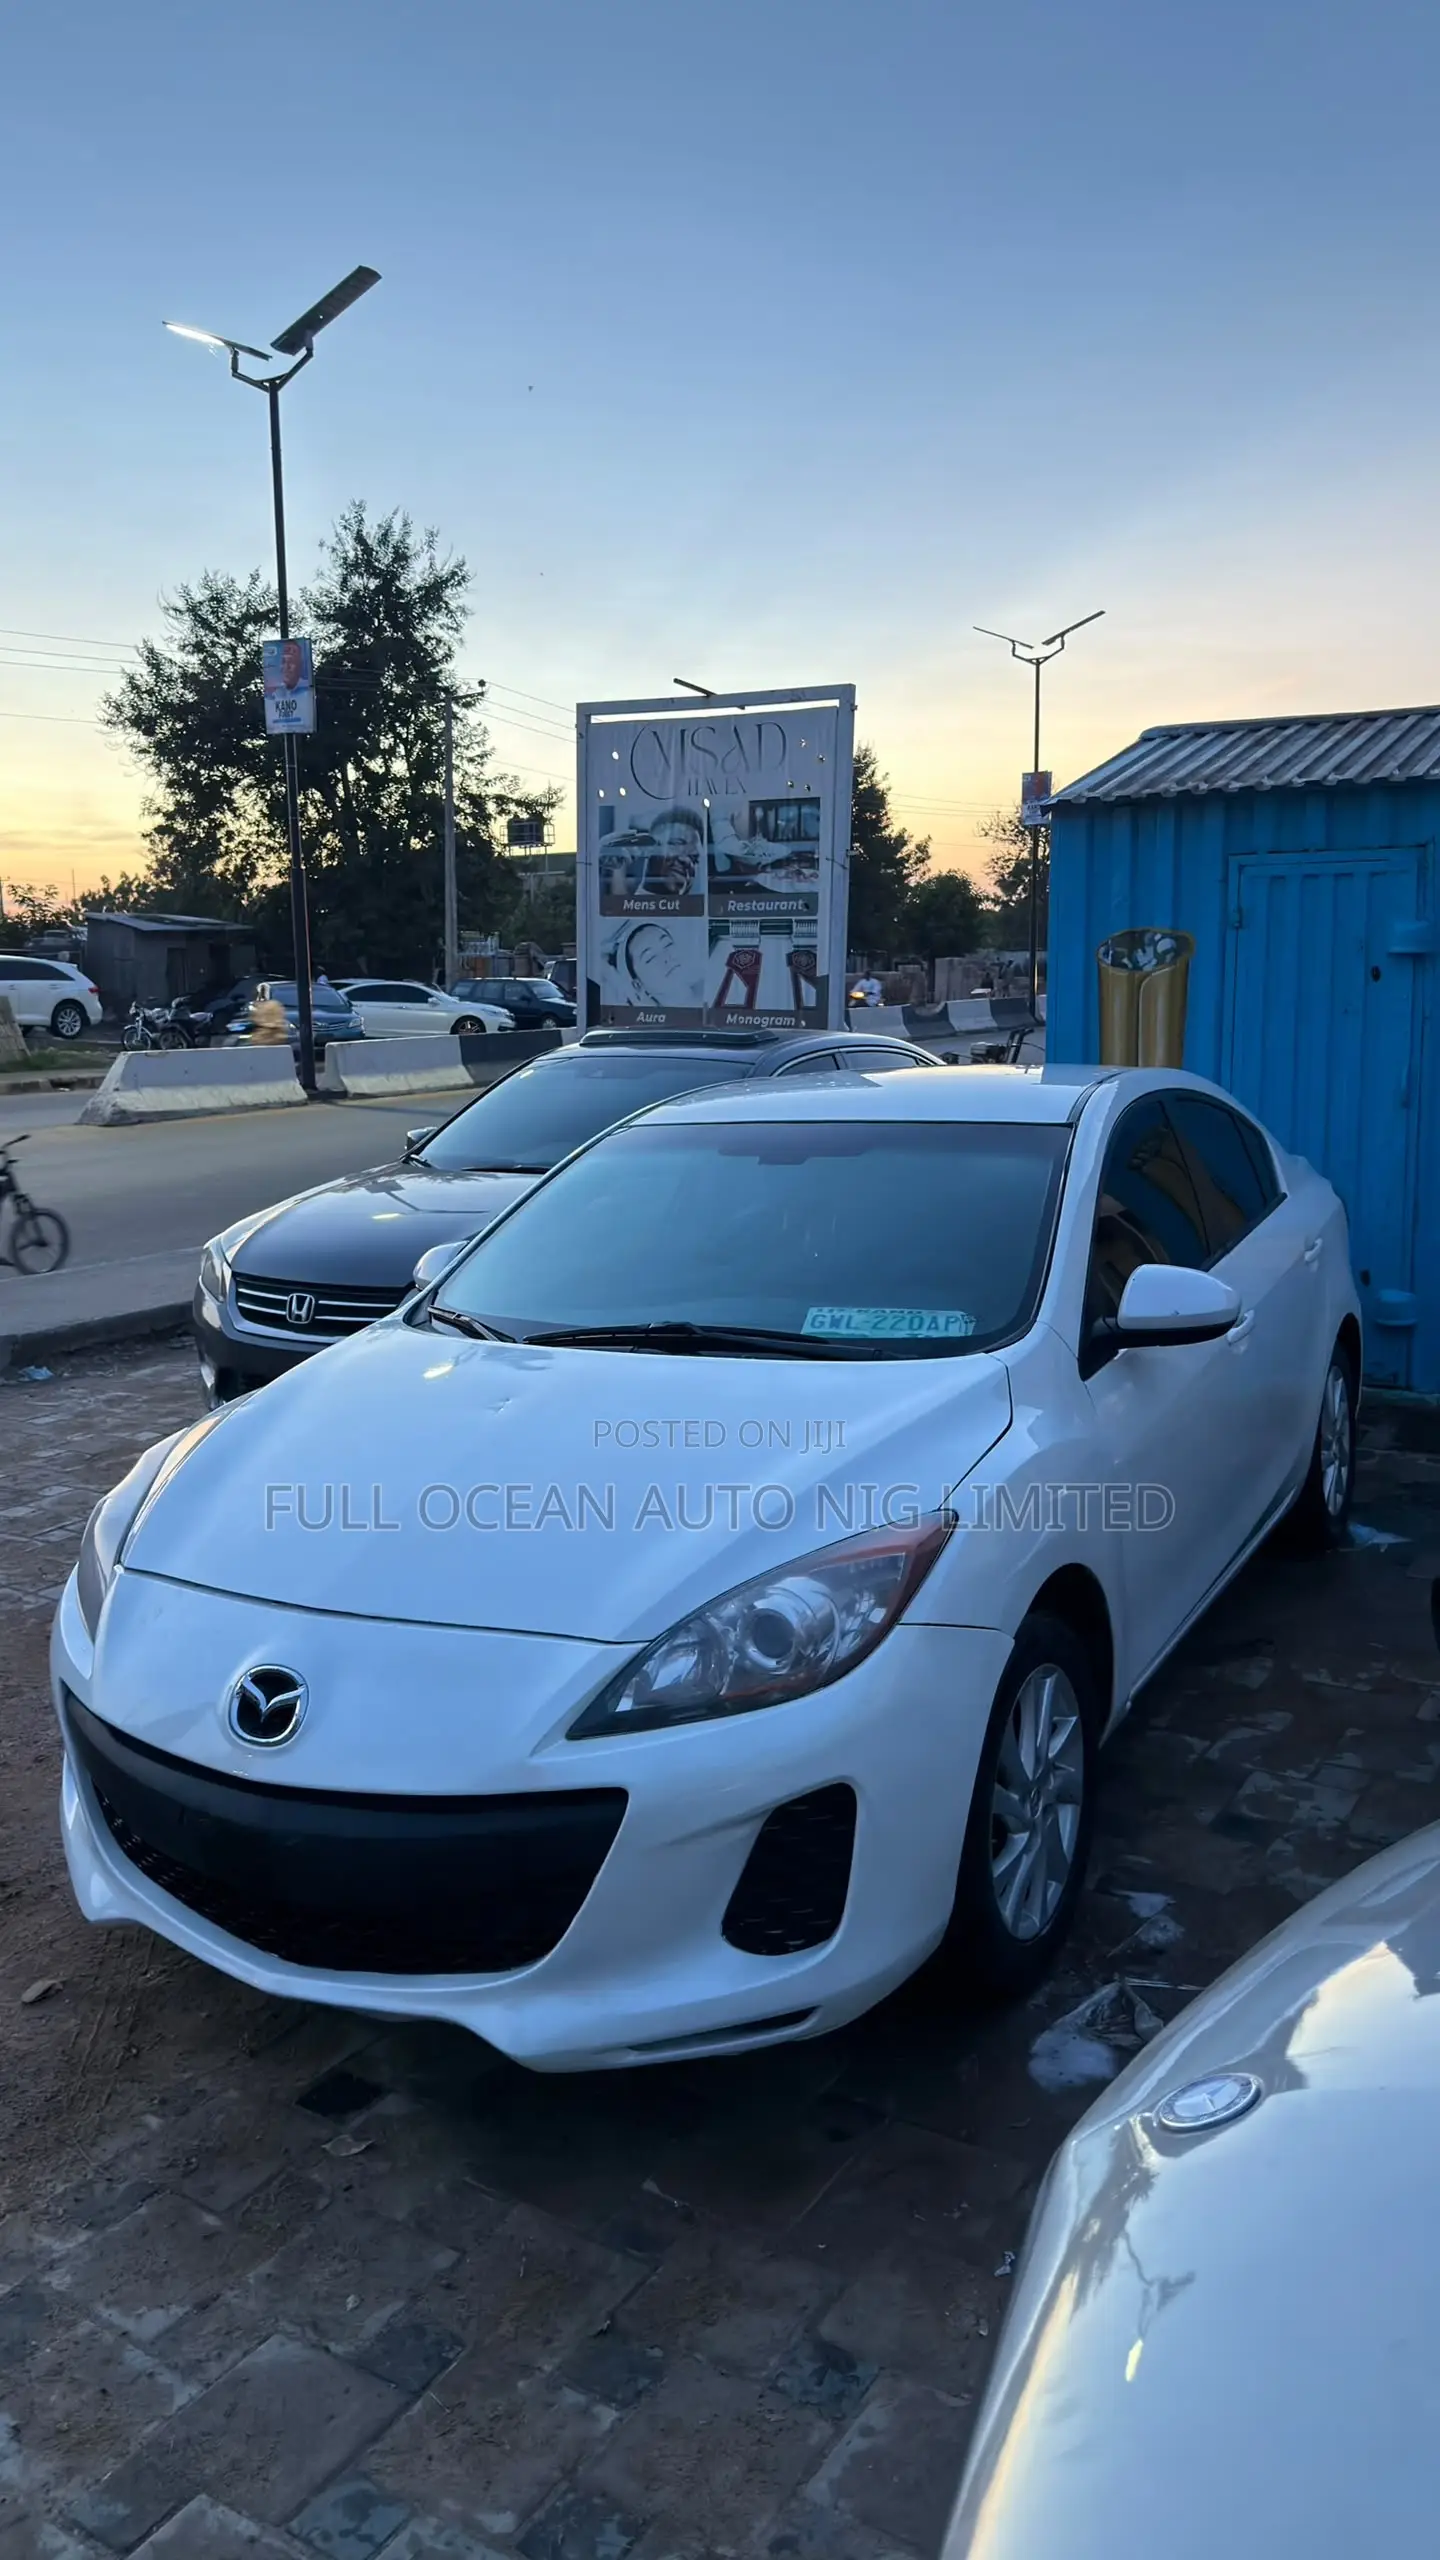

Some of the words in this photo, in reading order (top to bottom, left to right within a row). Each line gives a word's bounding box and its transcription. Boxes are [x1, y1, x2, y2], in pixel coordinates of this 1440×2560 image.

[623, 899, 656, 910] Mens
[659, 899, 680, 910] Cut
[727, 899, 804, 912] Restaurant
[636, 1011, 666, 1023] Aura
[726, 1013, 795, 1027] Monogram
